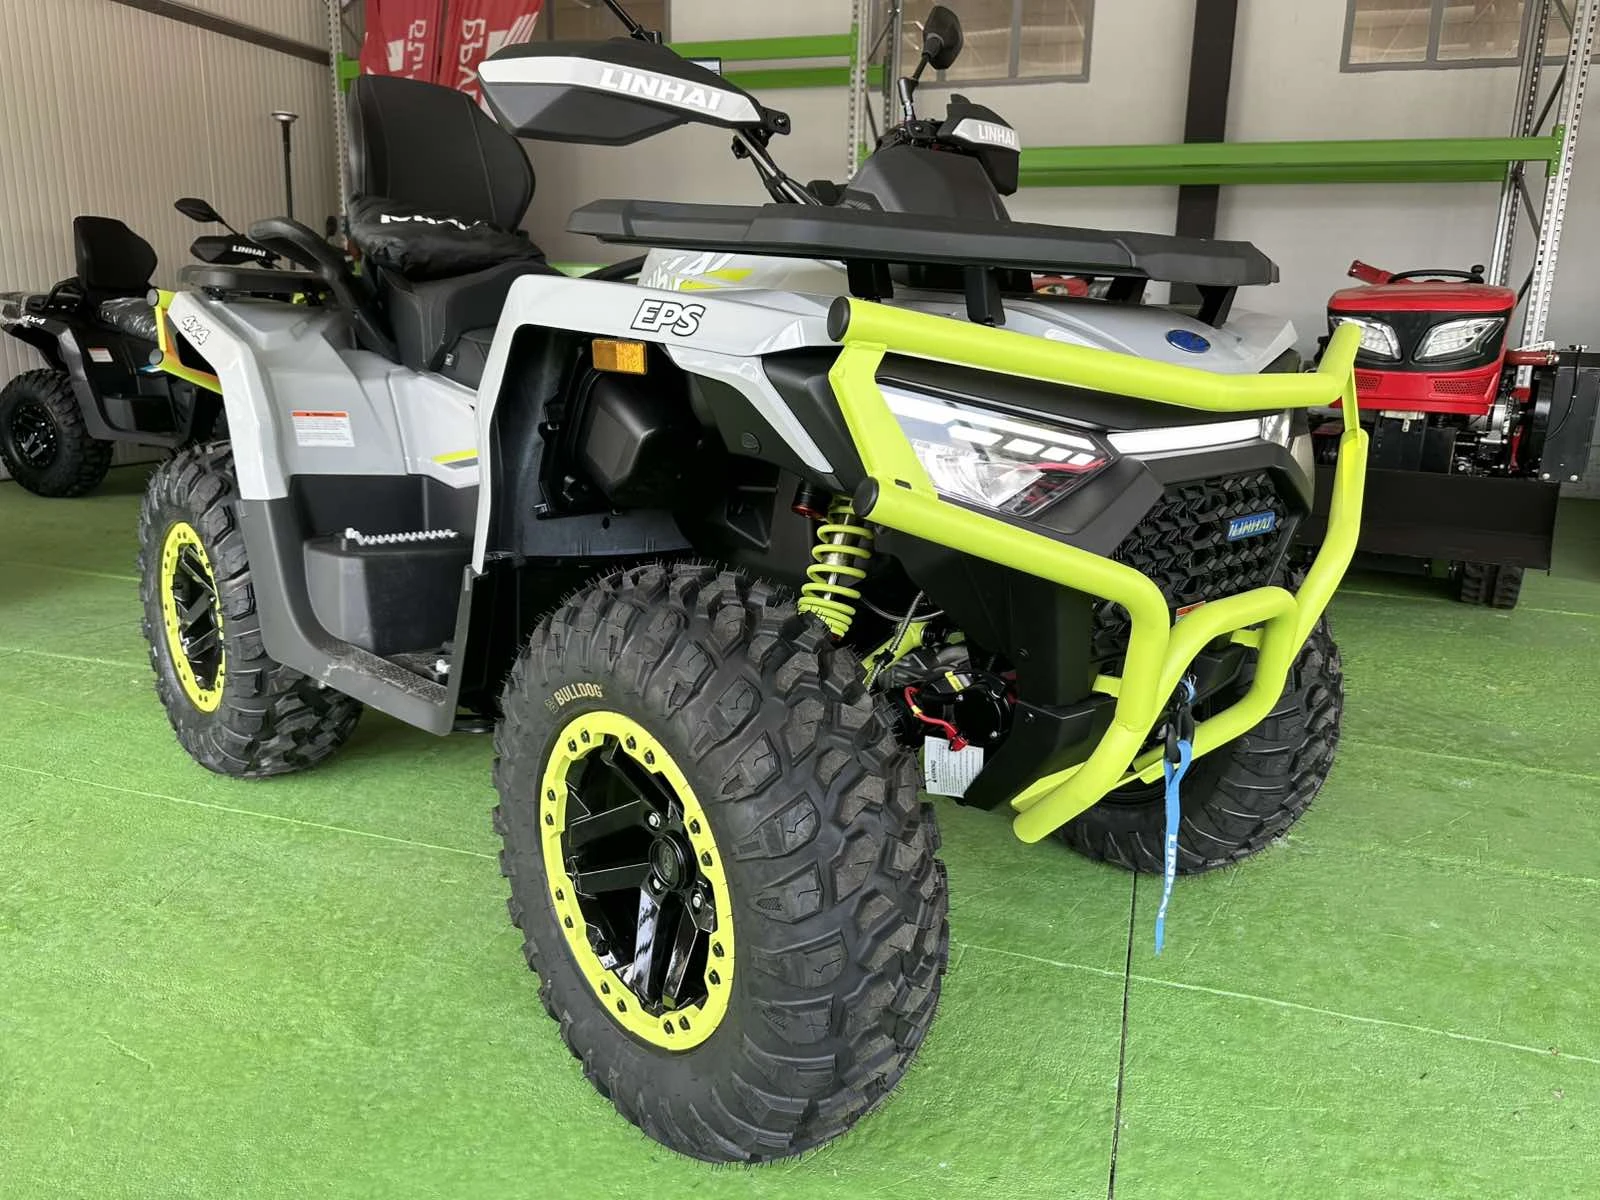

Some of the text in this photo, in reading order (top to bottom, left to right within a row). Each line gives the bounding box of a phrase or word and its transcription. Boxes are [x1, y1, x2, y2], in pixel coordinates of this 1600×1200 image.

[599, 67, 722, 110] LINHAI
[978, 124, 1015, 145] LINHAI
[232, 245, 266, 257] LINHAI
[630, 298, 706, 337] EPS
[553, 682, 603, 706] BULLDOG
